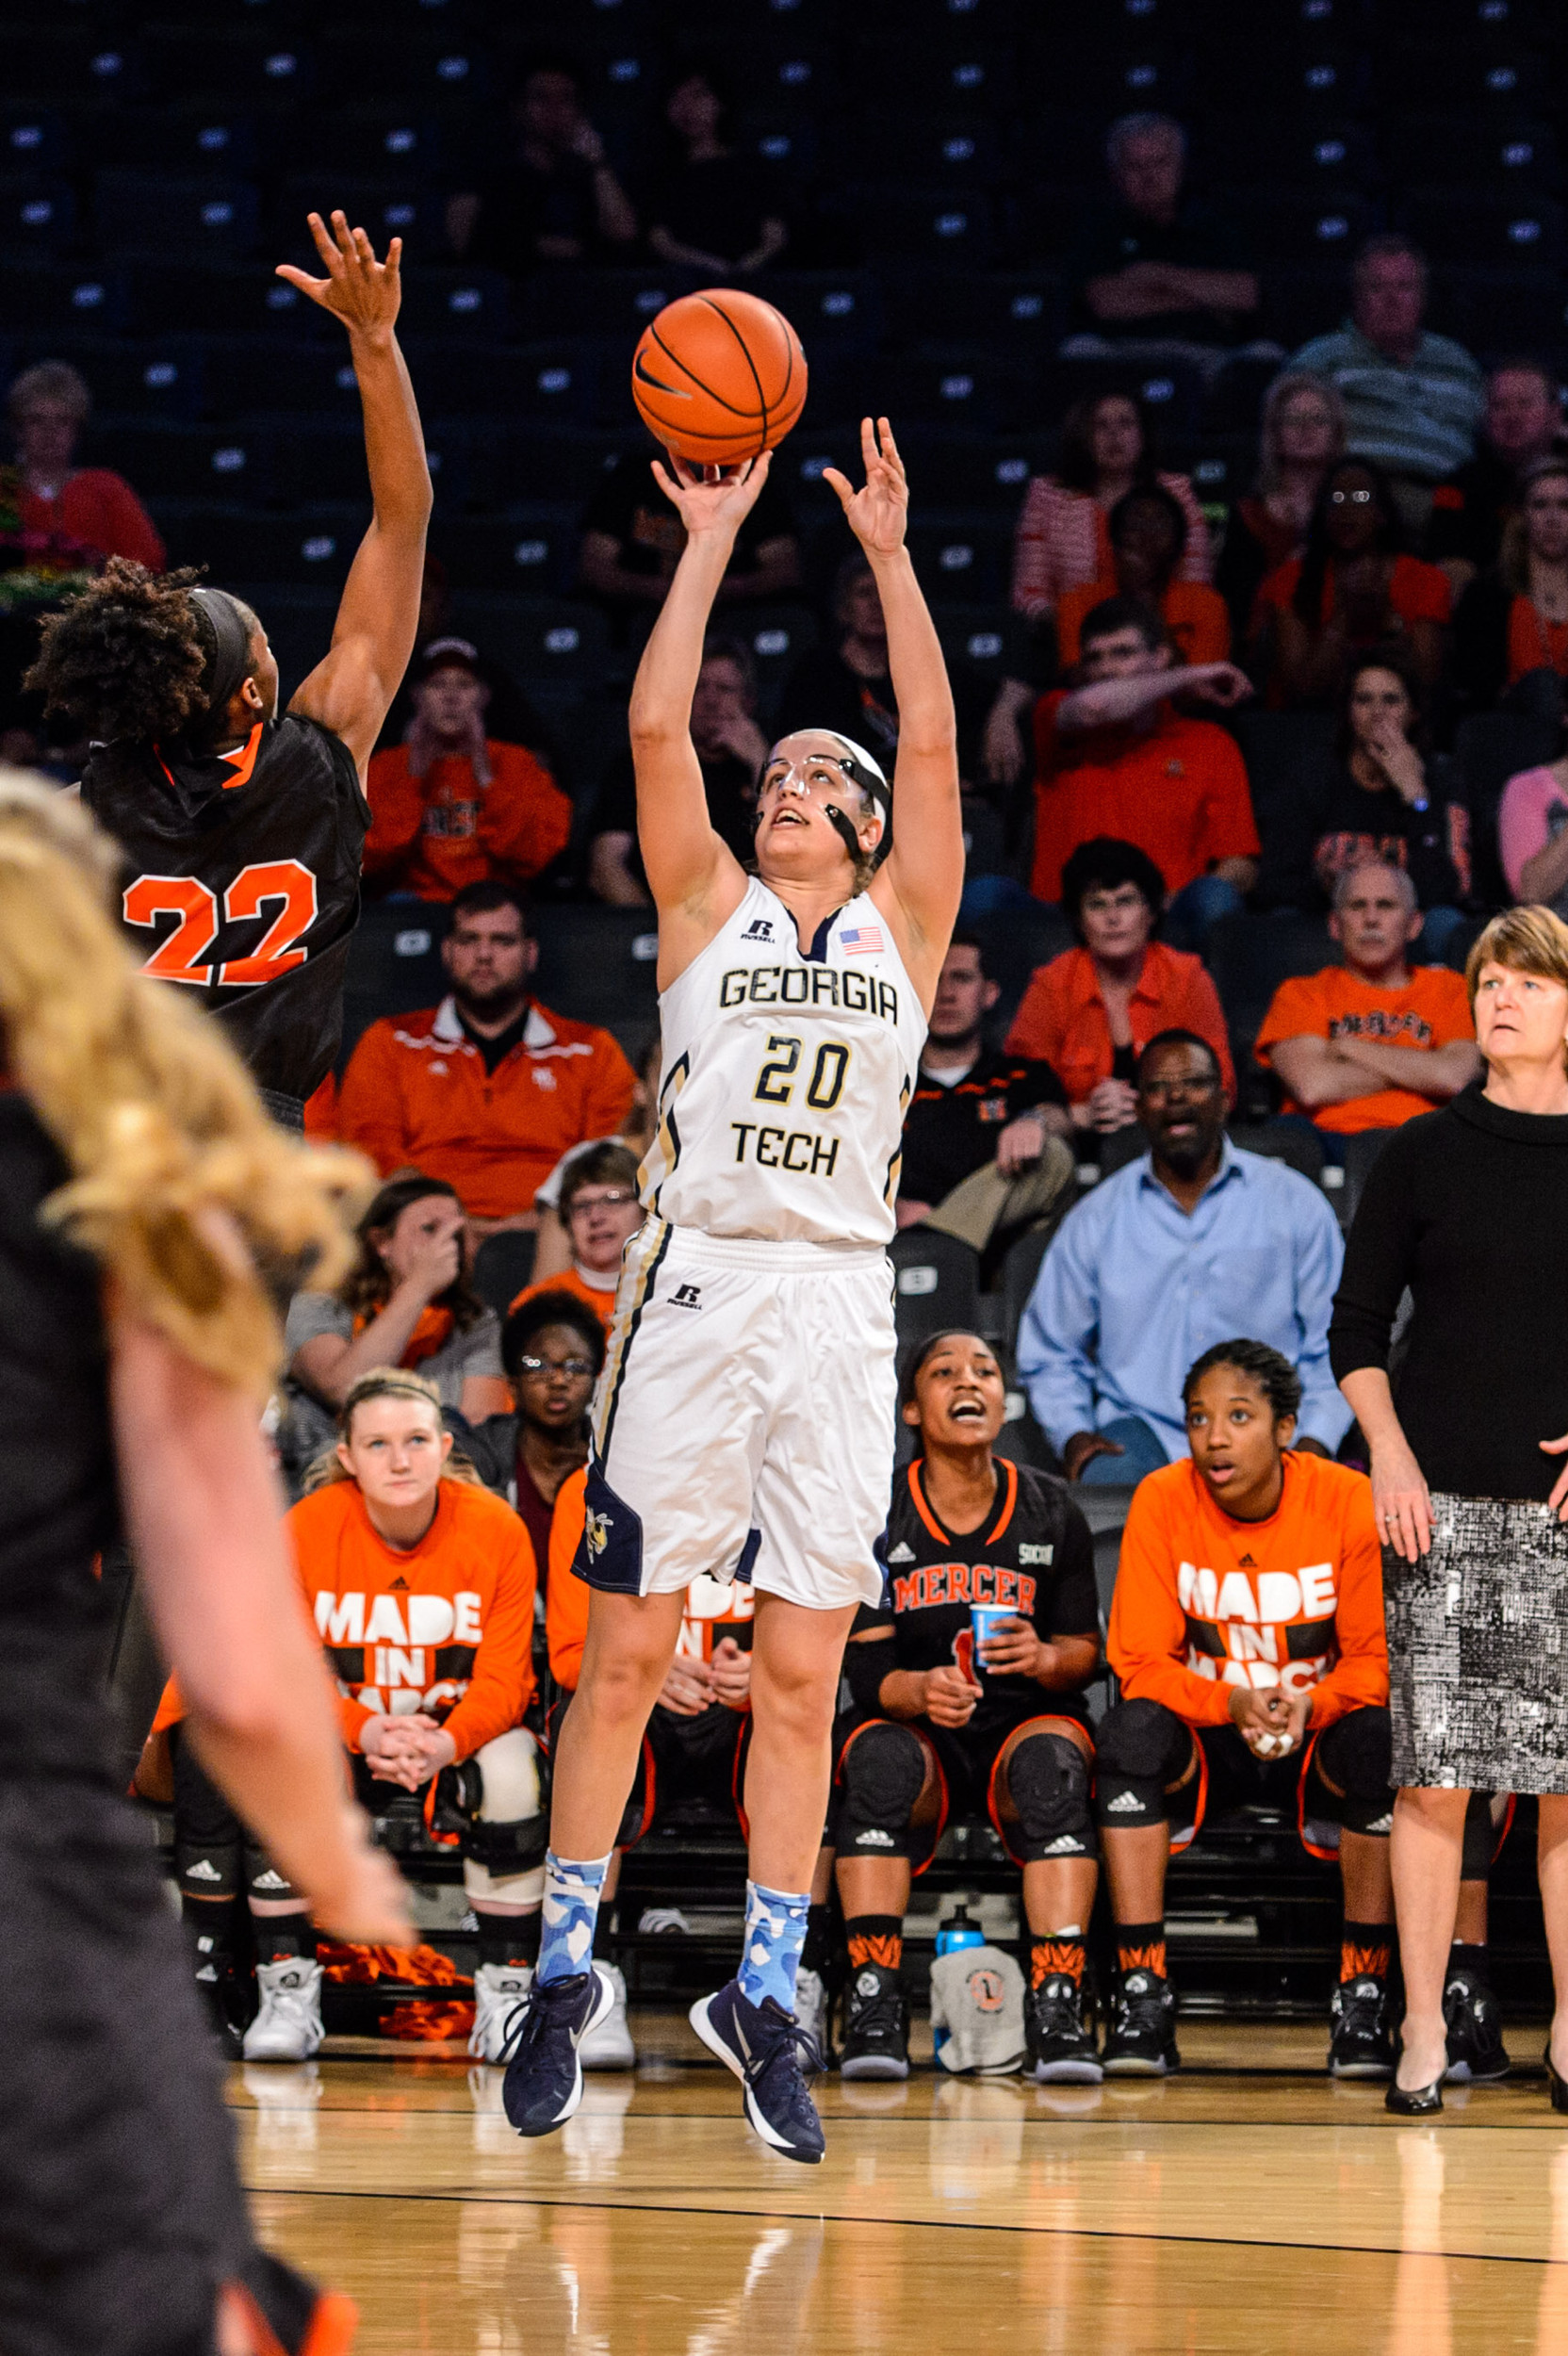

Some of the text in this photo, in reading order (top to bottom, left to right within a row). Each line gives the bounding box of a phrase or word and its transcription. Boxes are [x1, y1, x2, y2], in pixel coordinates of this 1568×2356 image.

[122, 859, 318, 987] 22
[741, 933, 776, 943] RUSSELL
[719, 965, 898, 1027] GEORGIA
[752, 1032, 852, 1112] 20
[730, 1120, 841, 1177] TECH
[666, 1298, 703, 1310] RUSSELL
[893, 1562, 1037, 1616] MERCER
[1179, 1561, 1338, 1623] MADE
[315, 1590, 482, 1646] MADE
[1228, 1623, 1279, 1663] IN
[374, 1645, 426, 1687] IN
